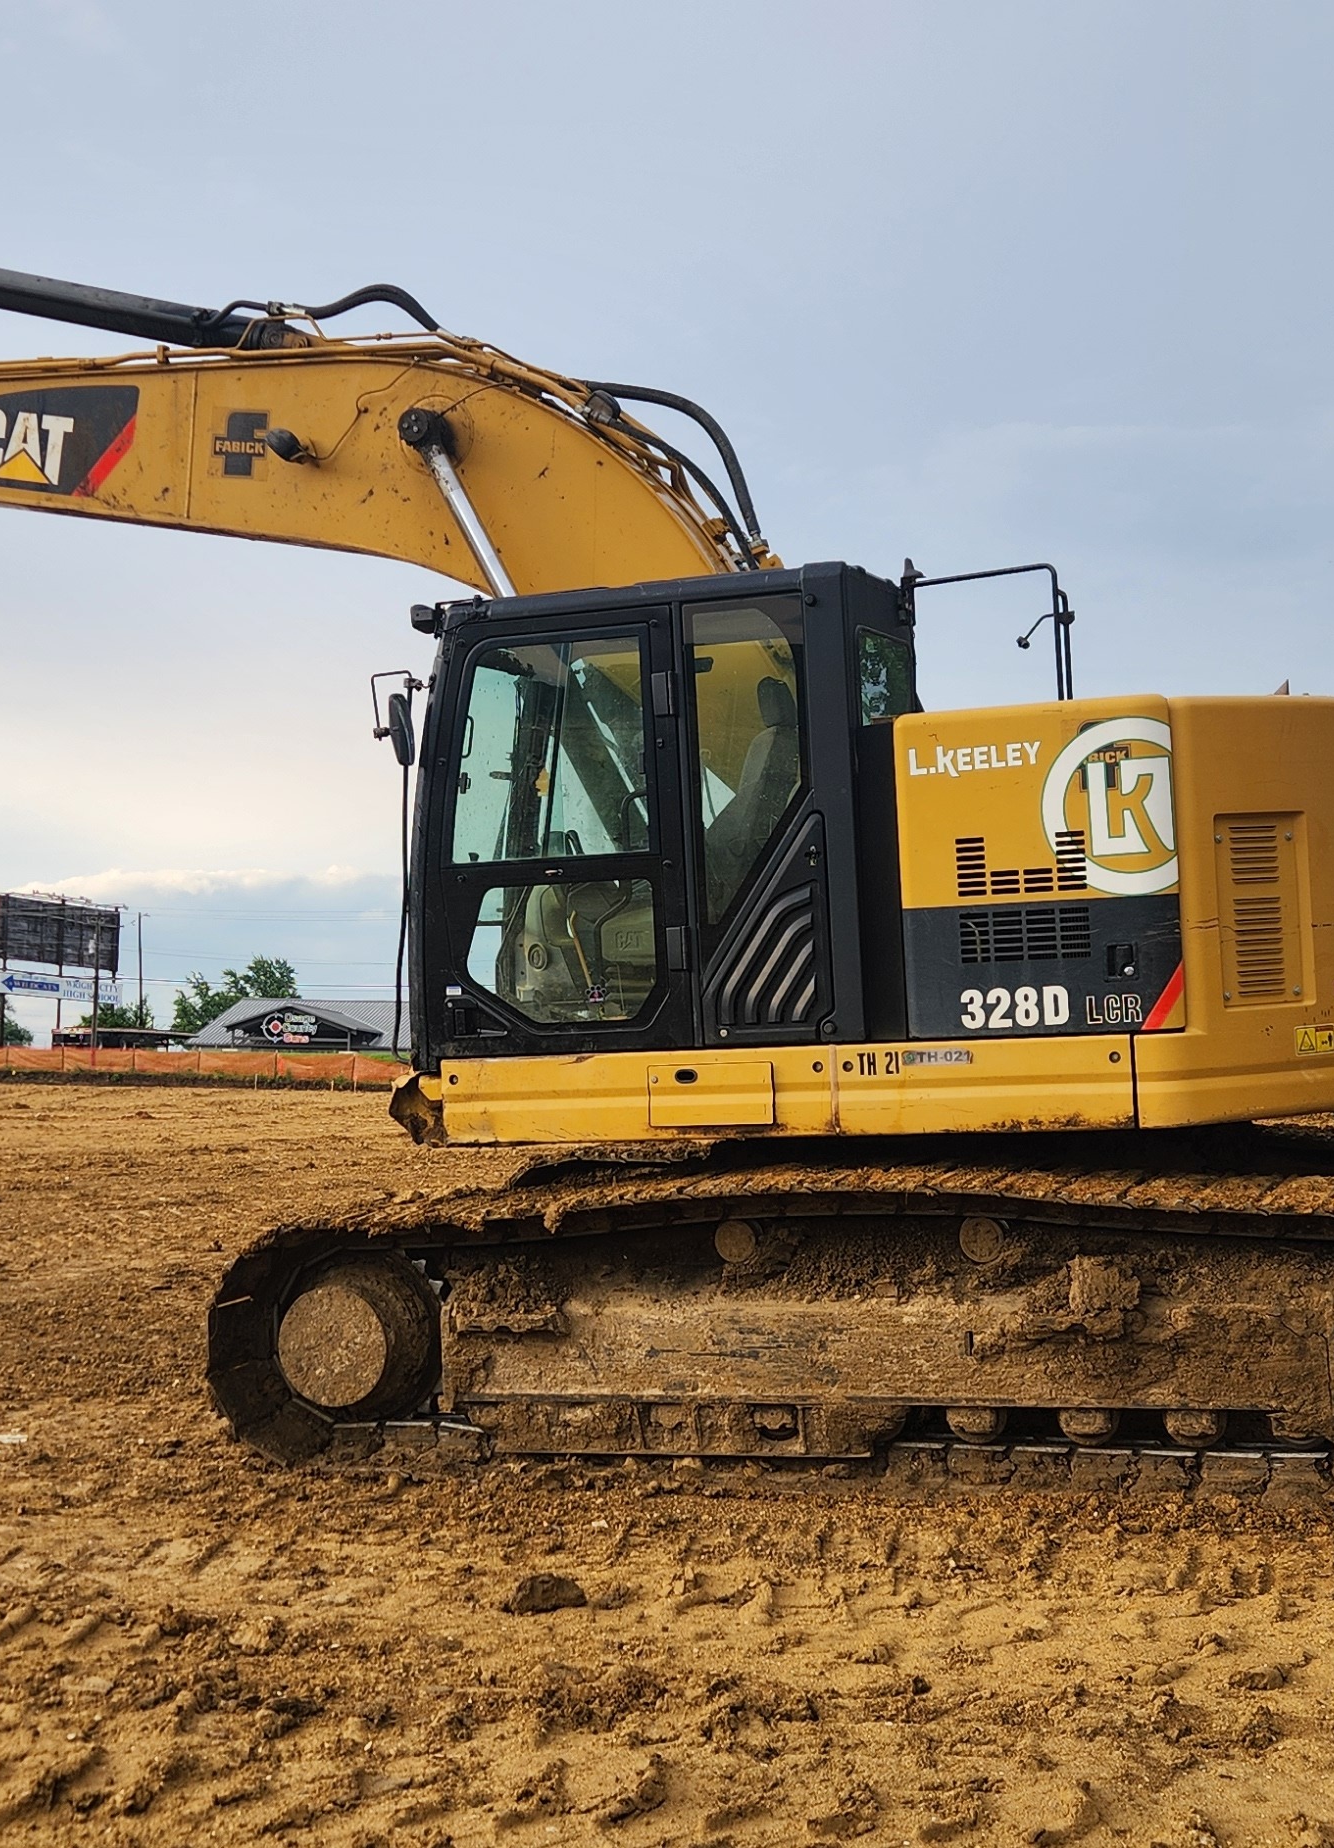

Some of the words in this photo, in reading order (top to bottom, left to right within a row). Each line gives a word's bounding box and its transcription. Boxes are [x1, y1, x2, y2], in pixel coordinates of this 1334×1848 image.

[215, 440, 264, 454] FABICK
[66, 980, 93, 990] WRIGH
[63, 990, 86, 999] HIGH
[88, 991, 119, 1002] SHOOL
[960, 985, 1070, 1030] 328D
[1085, 993, 1143, 1025] LCR
[916, 1050, 971, 1063] TH-021
[856, 1052, 878, 1076] TH
[884, 1051, 900, 1075] 21
